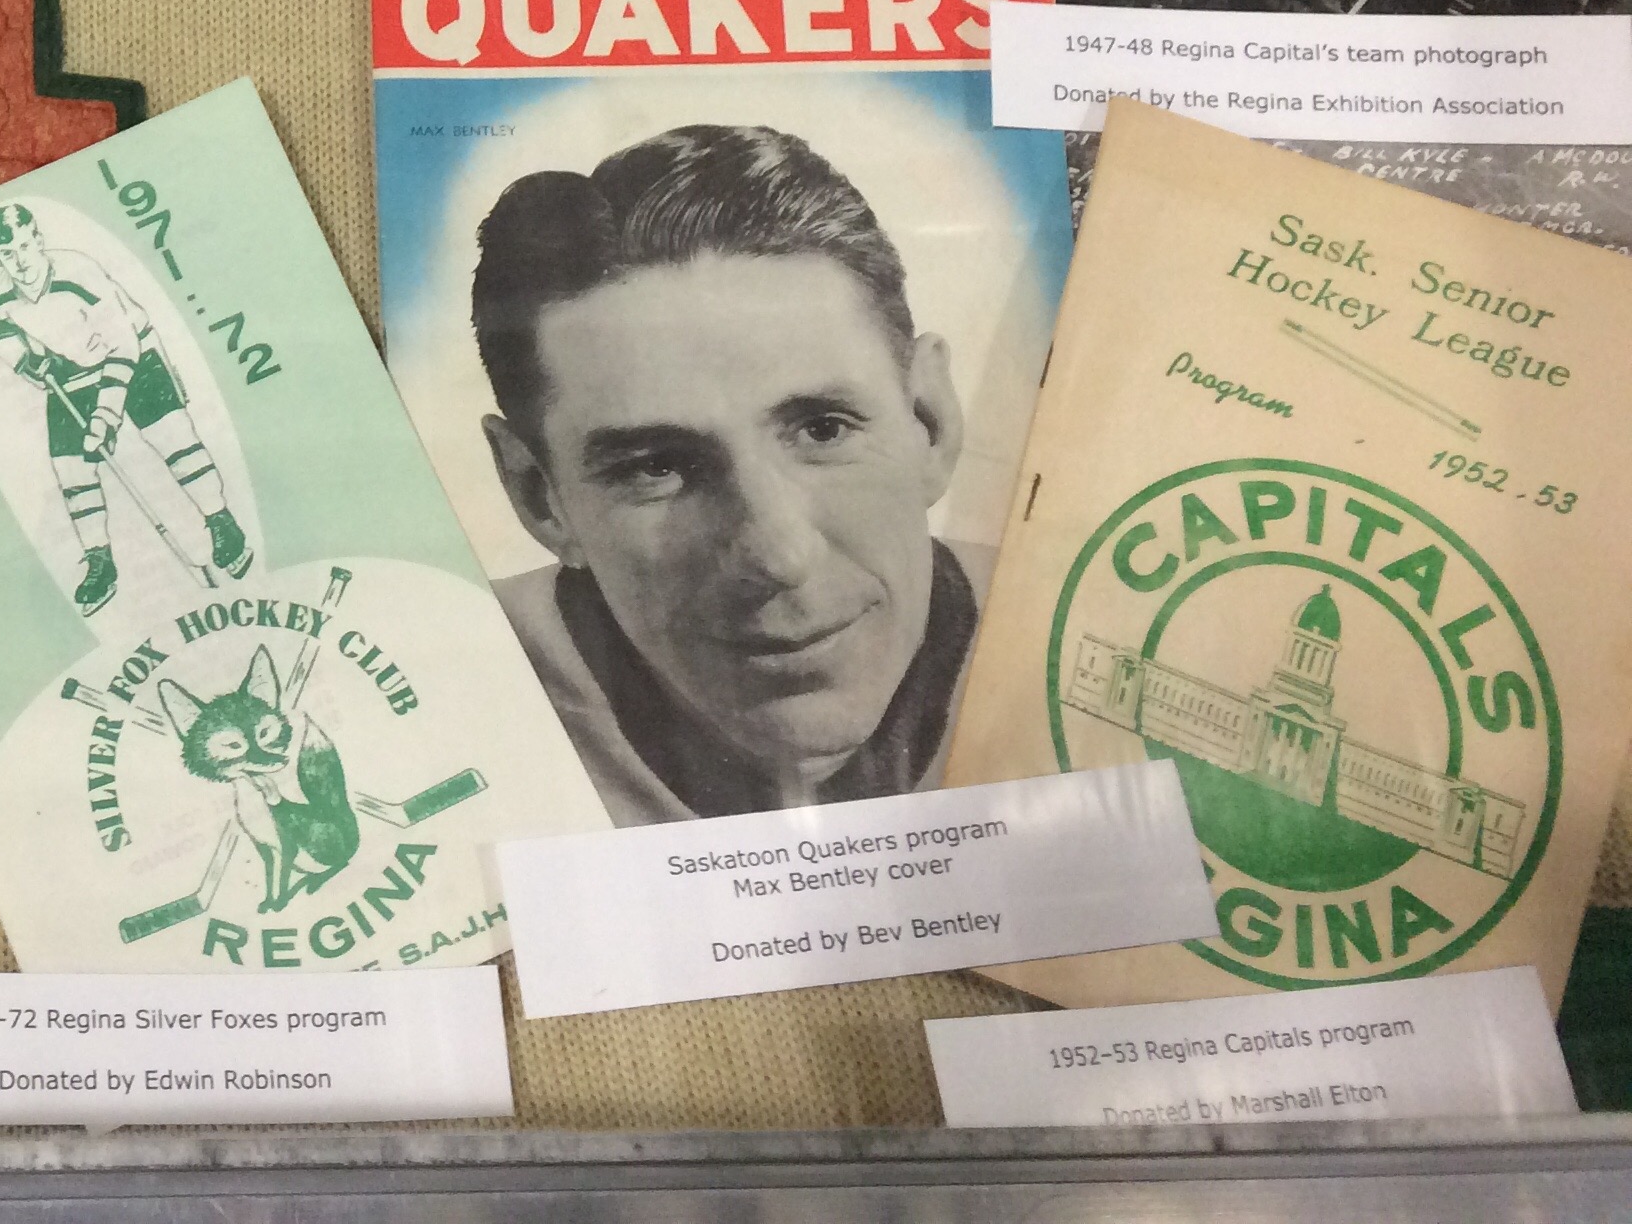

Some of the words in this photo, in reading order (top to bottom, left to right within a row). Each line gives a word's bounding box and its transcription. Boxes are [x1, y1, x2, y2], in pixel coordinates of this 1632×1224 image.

[1064, 35, 1153, 56] 1947-48
[1161, 39, 1235, 62] Regina
[1347, 45, 1405, 64] team
[1413, 44, 1548, 69] photograph
[1150, 88, 1176, 111] by
[1183, 90, 1219, 109] the
[1228, 91, 1303, 114] Regina
[1312, 94, 1424, 116] Exhibition
[1432, 95, 1564, 118] Association
[409, 125, 445, 138] MAX
[453, 124, 517, 138] BENTLEY
[1333, 145, 1387, 161] BILL
[1397, 147, 1470, 164] KYLE
[1356, 163, 1466, 184] CENTRE
[1269, 212, 1379, 277] Sask.
[1409, 259, 1558, 333] Senior
[1225, 247, 1392, 331] Hockey
[1409, 312, 1573, 389] League
[174, 598, 334, 646] HOCKEY
[1111, 479, 1537, 735] CAPITALS
[107, 637, 170, 706] FOX
[338, 630, 420, 718] CLUB
[87, 714, 134, 853] SILVER
[667, 841, 790, 878] Saskatoon
[797, 831, 899, 865] Quakers
[905, 815, 1008, 852] program
[733, 873, 784, 899] Max
[790, 864, 880, 893] Bentley
[887, 855, 954, 882] cover
[201, 841, 439, 969] REGINA
[1215, 884, 1455, 970] GINA
[398, 902, 509, 966] S.A.J.H
[711, 930, 812, 964] Donated
[819, 926, 849, 954] by
[857, 919, 903, 946] Bev
[911, 909, 1003, 939] Bentley
[47, 1008, 127, 1034] Regina
[134, 1008, 203, 1031] Silver
[210, 1008, 278, 1030] Foxes
[286, 1007, 387, 1034] program
[1048, 1040, 1139, 1070] 1952-53
[1145, 1036, 1220, 1065] Regina
[1224, 1025, 1313, 1056] Capitals
[1318, 1017, 1416, 1048] program
[106, 1068, 136, 1095] by
[143, 1068, 216, 1092] Edwin
[224, 1067, 333, 1091] Robinson
[1195, 1097, 1224, 1123] by
[1230, 1086, 1322, 1116] Marshall
[1329, 1082, 1389, 1106] Elton
